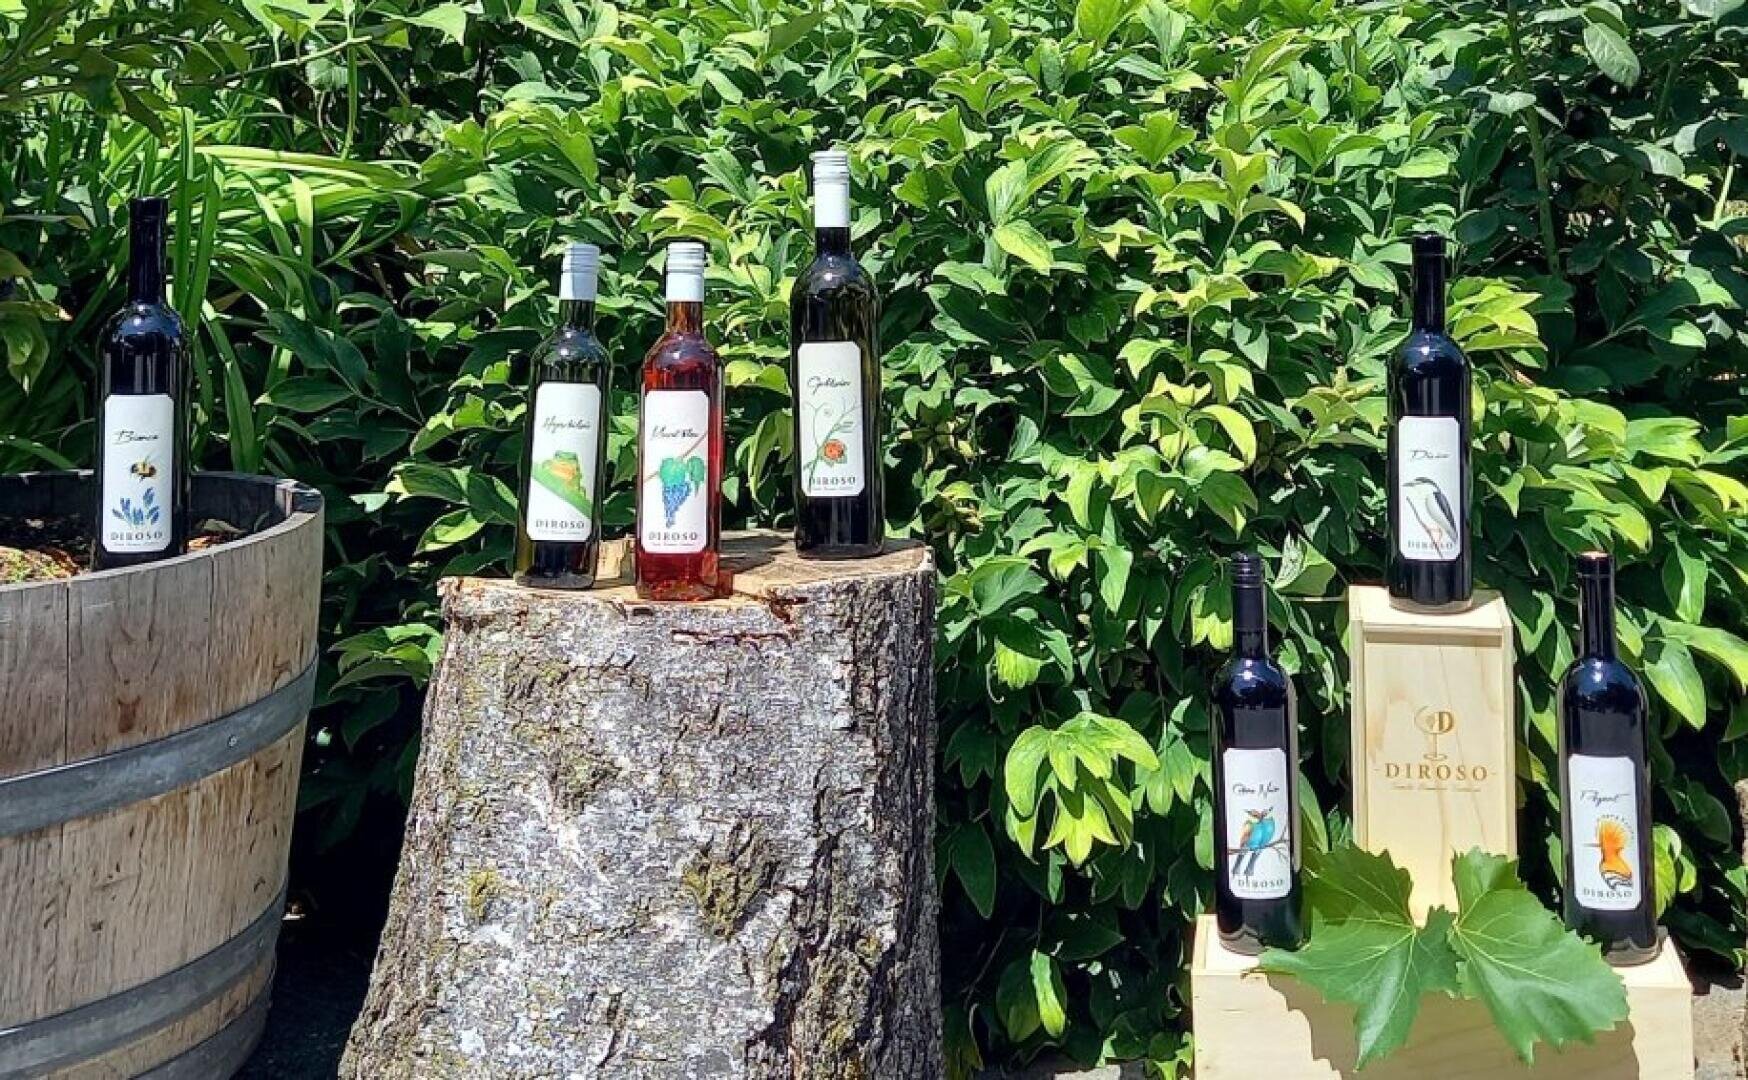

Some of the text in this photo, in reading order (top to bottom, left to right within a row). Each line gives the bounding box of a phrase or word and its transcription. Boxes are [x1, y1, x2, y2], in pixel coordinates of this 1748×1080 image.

[535, 519, 585, 529] DIROSO
[110, 531, 163, 541] DIROSO
[648, 531, 698, 541] DIROSO
[1385, 763, 1488, 781] DIROSO
